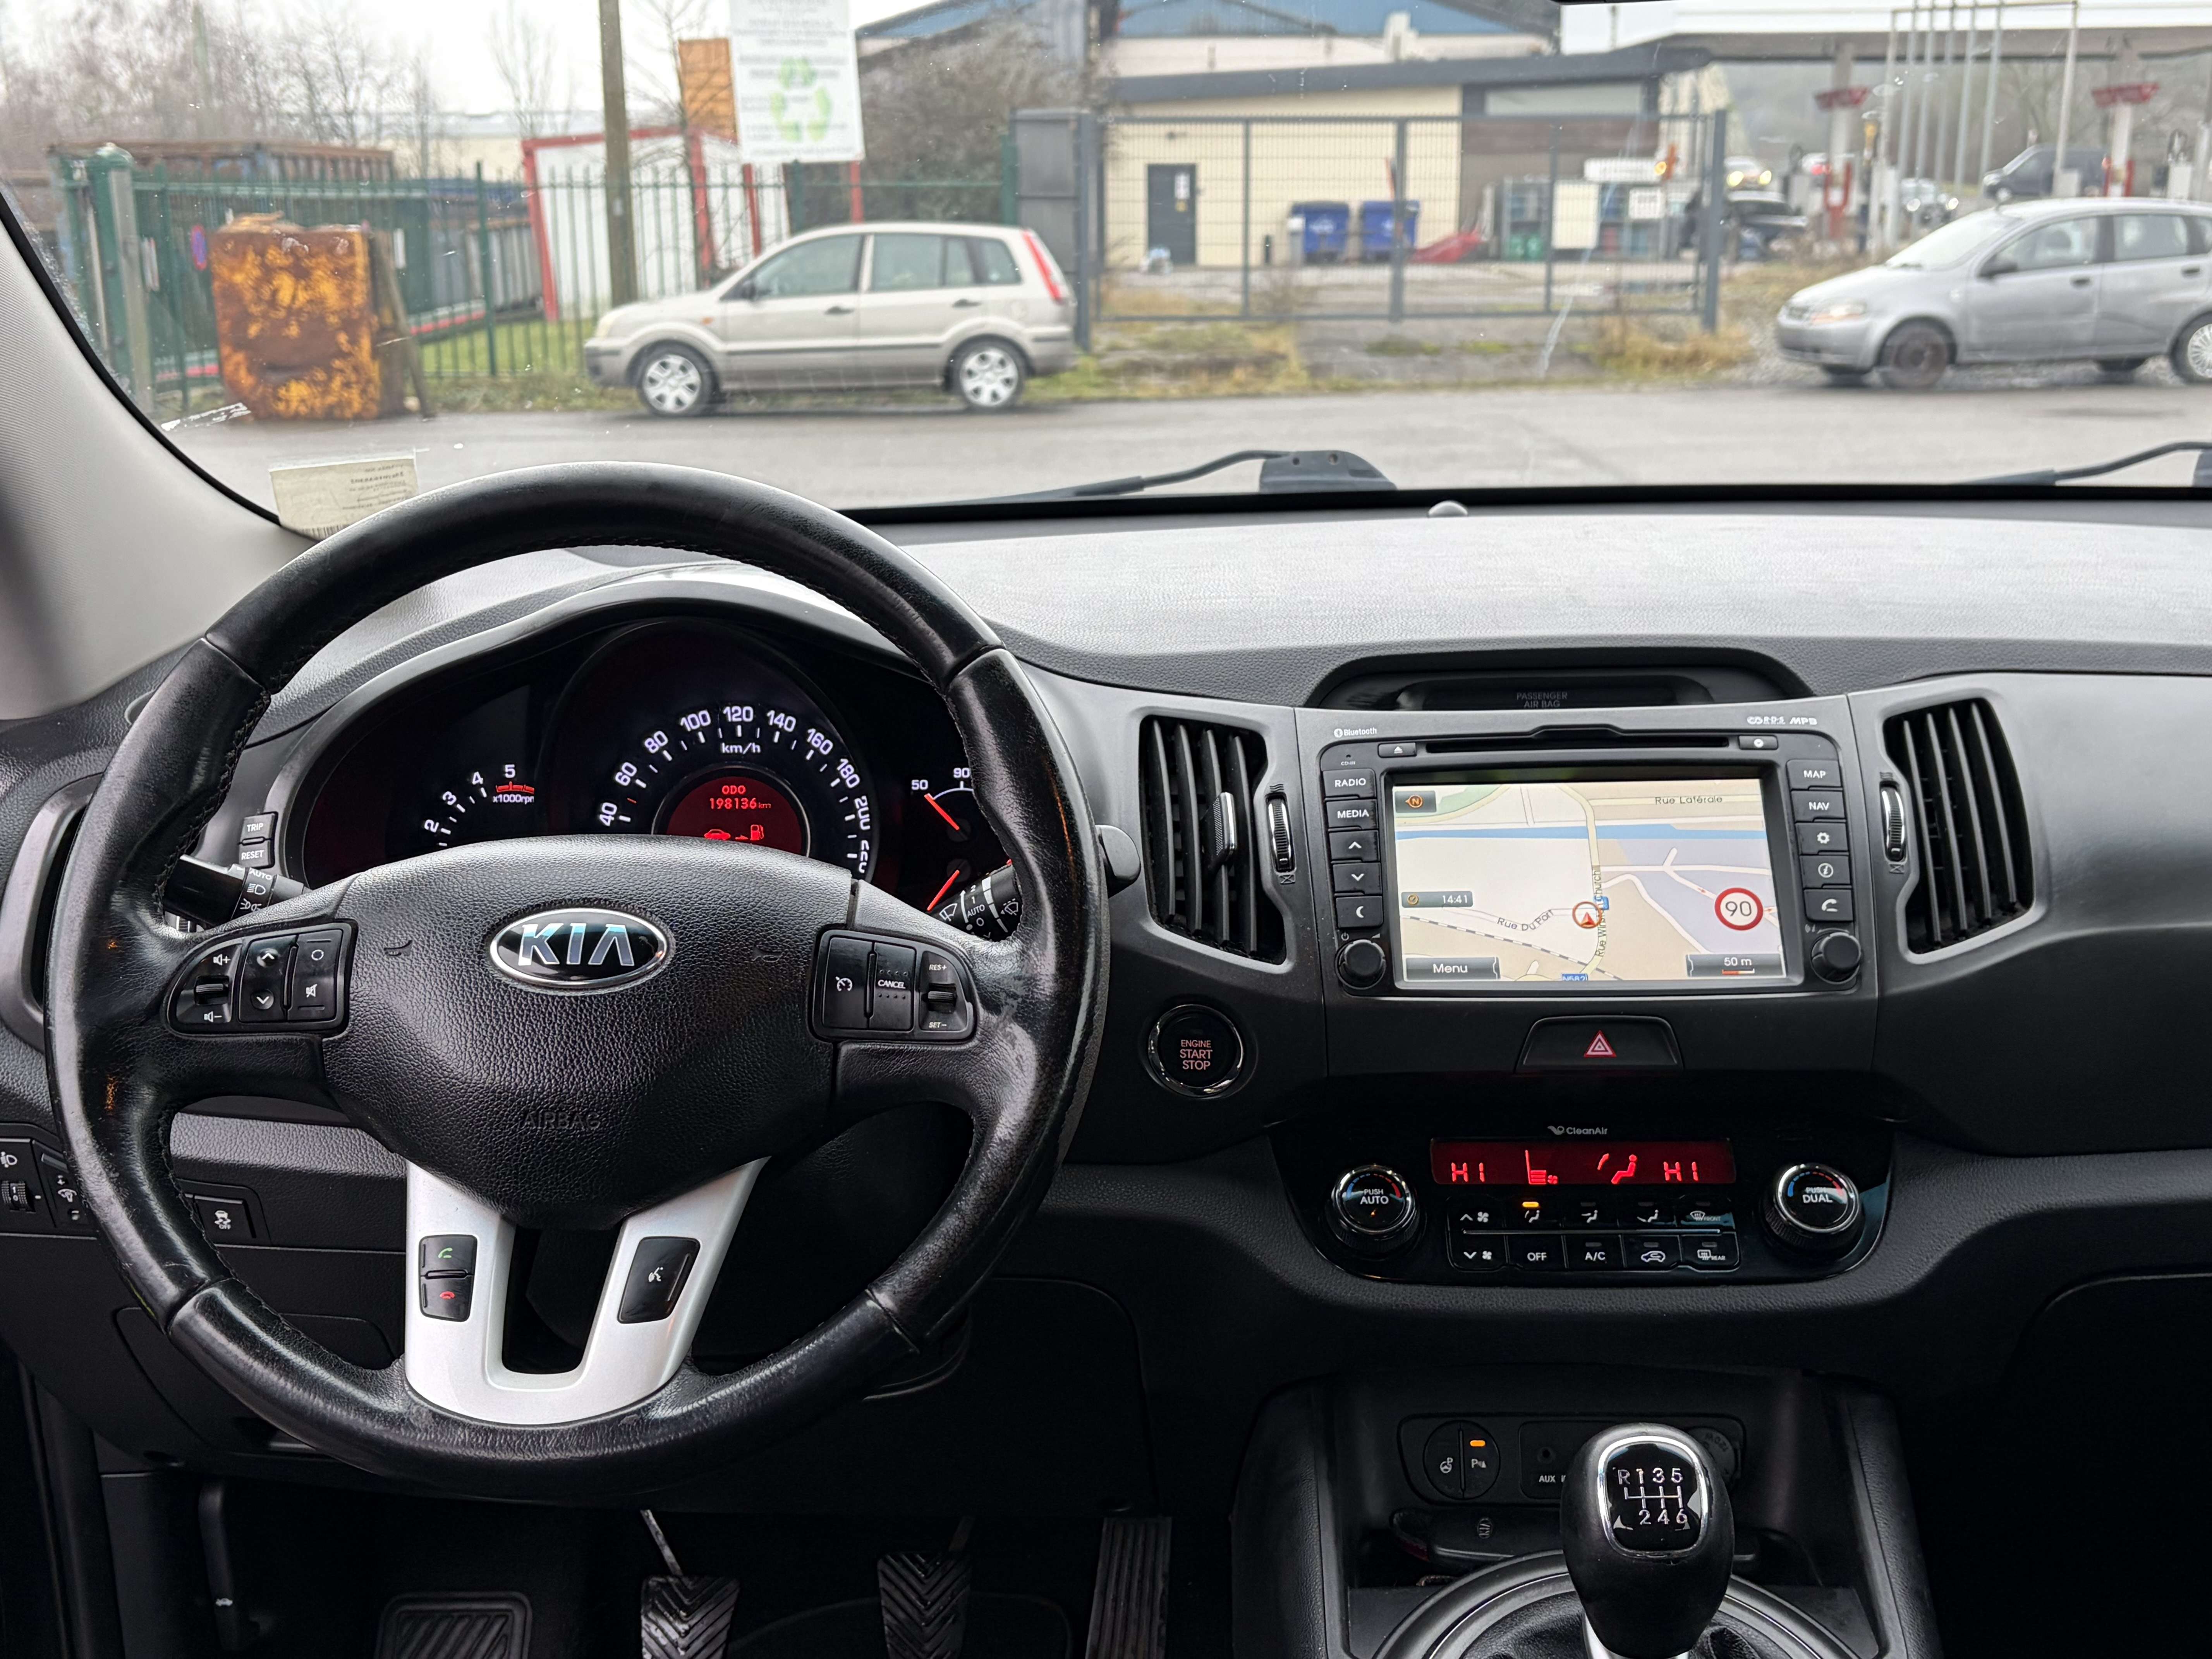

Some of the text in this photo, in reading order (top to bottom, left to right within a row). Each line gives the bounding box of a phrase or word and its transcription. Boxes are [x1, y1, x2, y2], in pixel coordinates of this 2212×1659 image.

[1516, 692, 1568, 700] PASSENGER
[723, 706, 754, 722] 120
[680, 710, 711, 732] 100
[767, 710, 796, 732] 140
[1344, 727, 1377, 736] Bluetooth
[644, 731, 668, 753] 80
[807, 728, 833, 755] 160
[721, 743, 761, 754] km/h
[505, 764, 515, 778] 5
[615, 762, 637, 786] 60
[836, 759, 860, 788] 180
[953, 768, 970, 778] 90
[1803, 770, 1826, 779] MAP
[472, 771, 483, 785] 4
[1334, 778, 1366, 787] RADIO
[722, 785, 746, 794] ODO
[911, 780, 928, 790] 50
[442, 791, 457, 805] 3
[1680, 795, 1723, 804] Latérale
[1809, 802, 1829, 811] NAV
[599, 802, 617, 826] 40
[1337, 809, 1369, 819] MEDIA
[247, 823, 264, 832] TRIP
[424, 819, 439, 833] 2
[241, 850, 264, 860] RESET
[249, 869, 272, 880] AUTO
[1443, 895, 1468, 903] 14:41
[967, 904, 985, 918] AUTO
[1725, 901, 1752, 917] 90
[1497, 917, 1518, 929] Rue
[518, 923, 634, 966] KIA
[1724, 957, 1738, 966] 50
[1433, 963, 1468, 973] Menu
[878, 979, 906, 989] CANCEL
[1181, 1039, 1211, 1048] ENGINE
[1180, 1049, 1213, 1059] START
[1182, 1060, 1211, 1070] STOP
[524, 1111, 601, 1130] AIRBAG
[1566, 1127, 1608, 1135] CleanAir
[1360, 1196, 1389, 1204] AUTO
[1803, 1194, 1832, 1203] DUAL
[1527, 1252, 1547, 1261] OFF
[1585, 1252, 1606, 1261] A/C
[1618, 1467, 1683, 1485] R 1 3 5
[1639, 1509, 1688, 1525] 2 4 6
